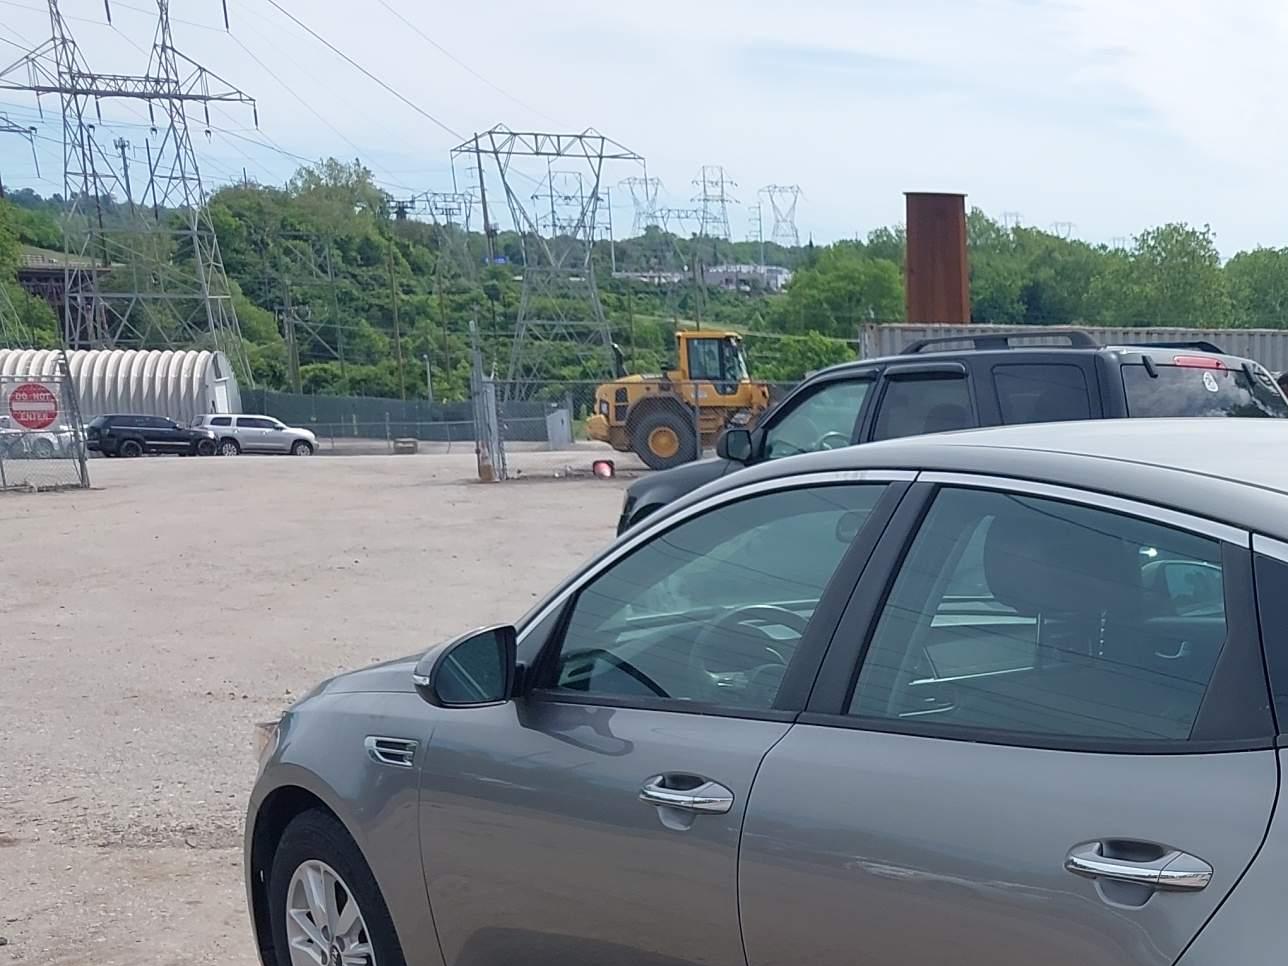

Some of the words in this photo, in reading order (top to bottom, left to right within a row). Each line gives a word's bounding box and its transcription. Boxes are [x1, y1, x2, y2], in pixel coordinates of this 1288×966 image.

[15, 392, 28, 400] DO
[33, 392, 49, 400] NOT
[21, 411, 49, 420] ENTER
